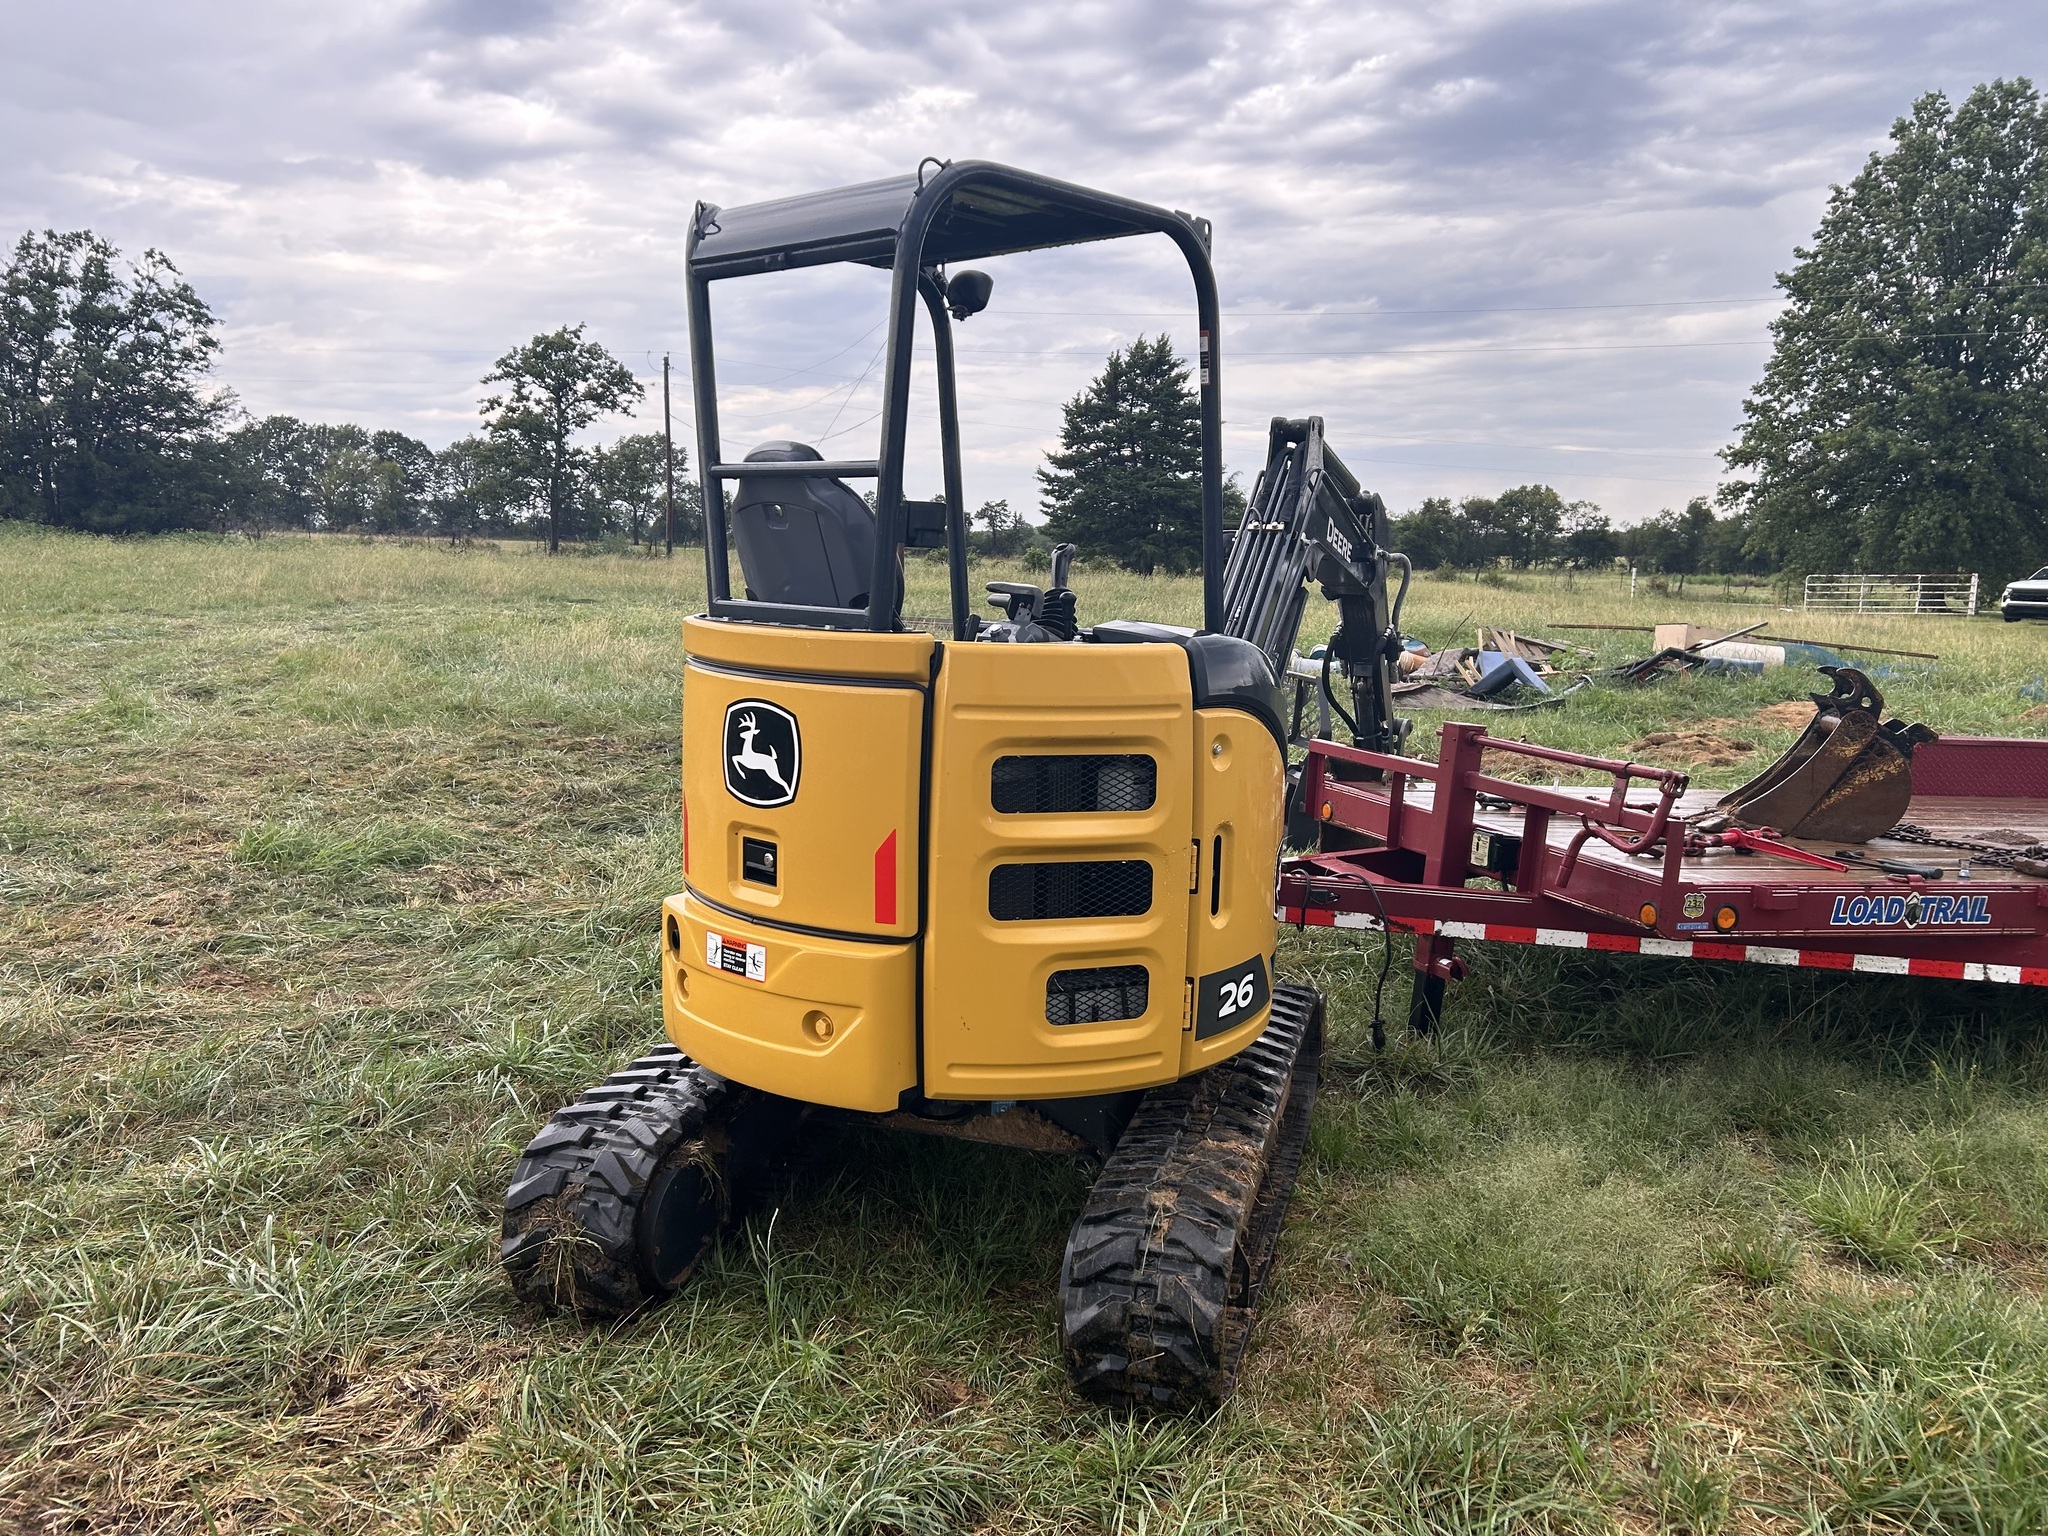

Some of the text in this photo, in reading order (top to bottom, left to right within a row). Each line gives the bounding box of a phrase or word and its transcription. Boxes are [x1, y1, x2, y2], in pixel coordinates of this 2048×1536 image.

[1326, 516, 1353, 564] DEERE
[1830, 896, 1992, 925] LOAD TRAIL
[1218, 973, 1254, 1018] 26
